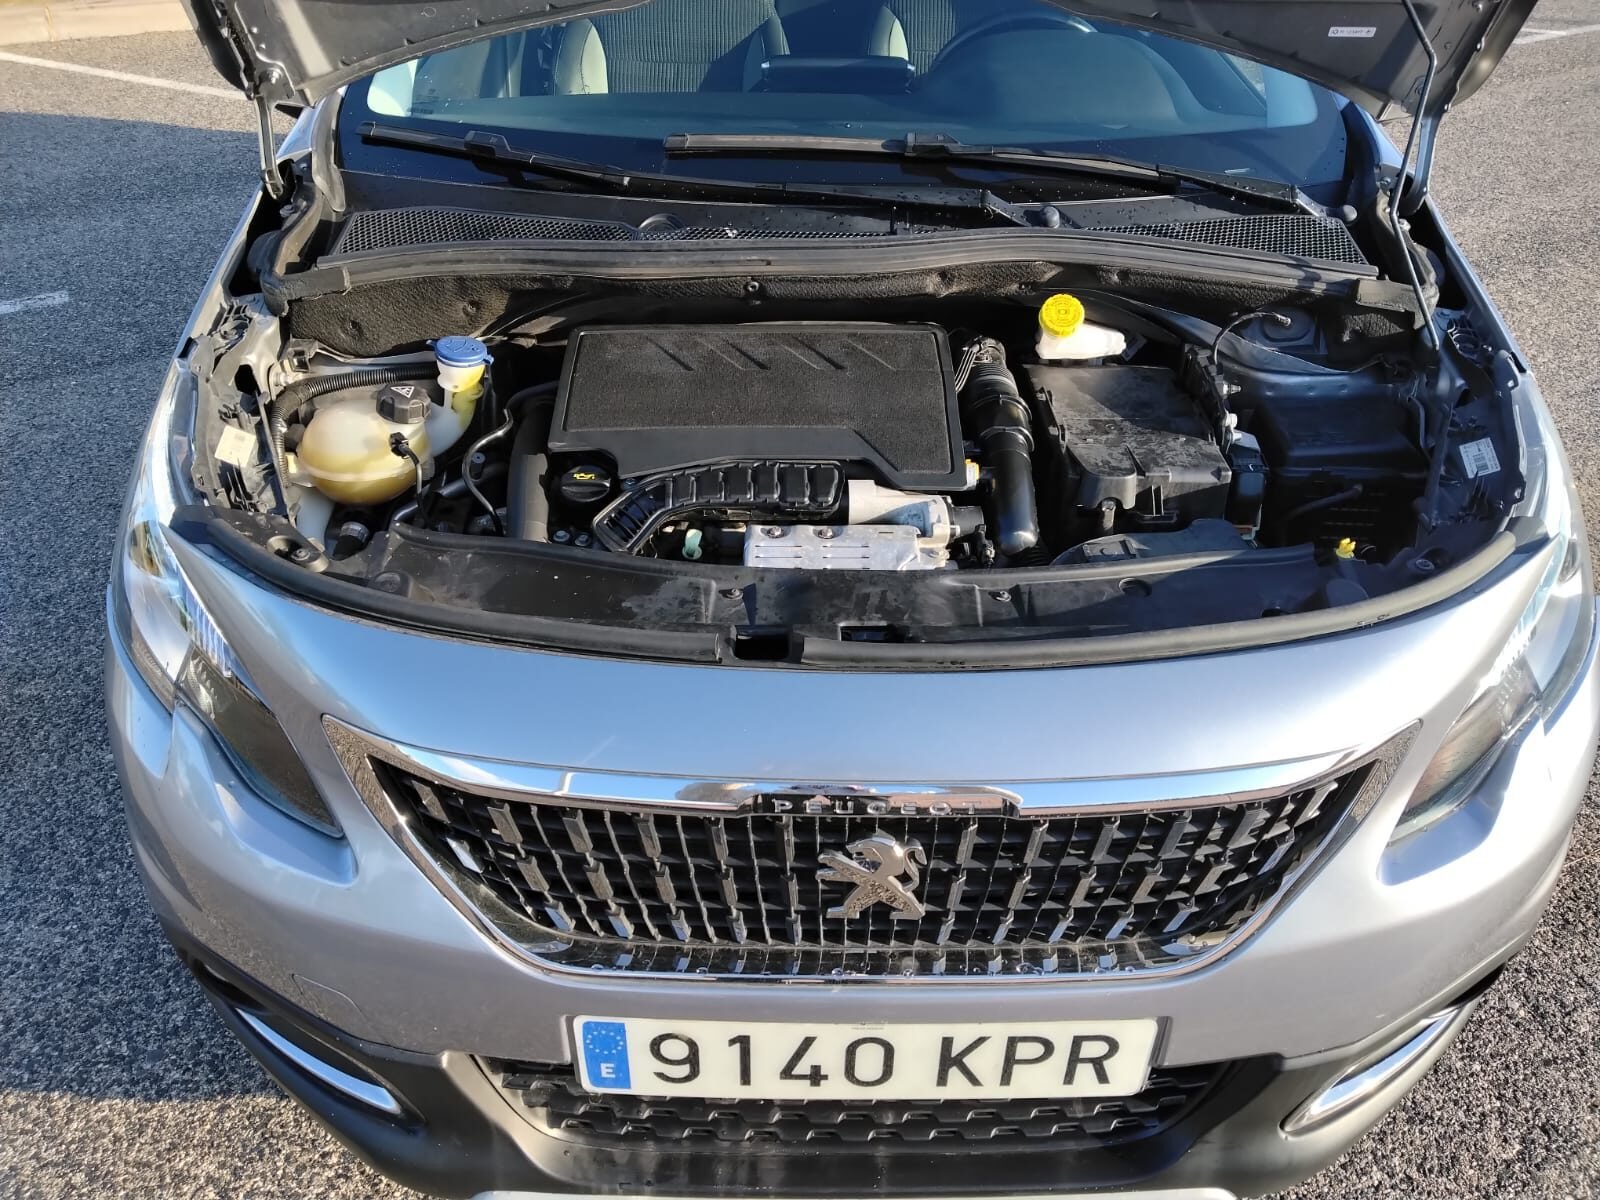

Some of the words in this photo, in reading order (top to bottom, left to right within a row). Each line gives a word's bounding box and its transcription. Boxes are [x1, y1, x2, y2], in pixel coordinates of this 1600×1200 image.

[772, 799, 981, 815] PEUGEOT
[649, 1032, 896, 1088] 9140
[936, 1035, 1121, 1088] KPR
[601, 1063, 616, 1079] E
